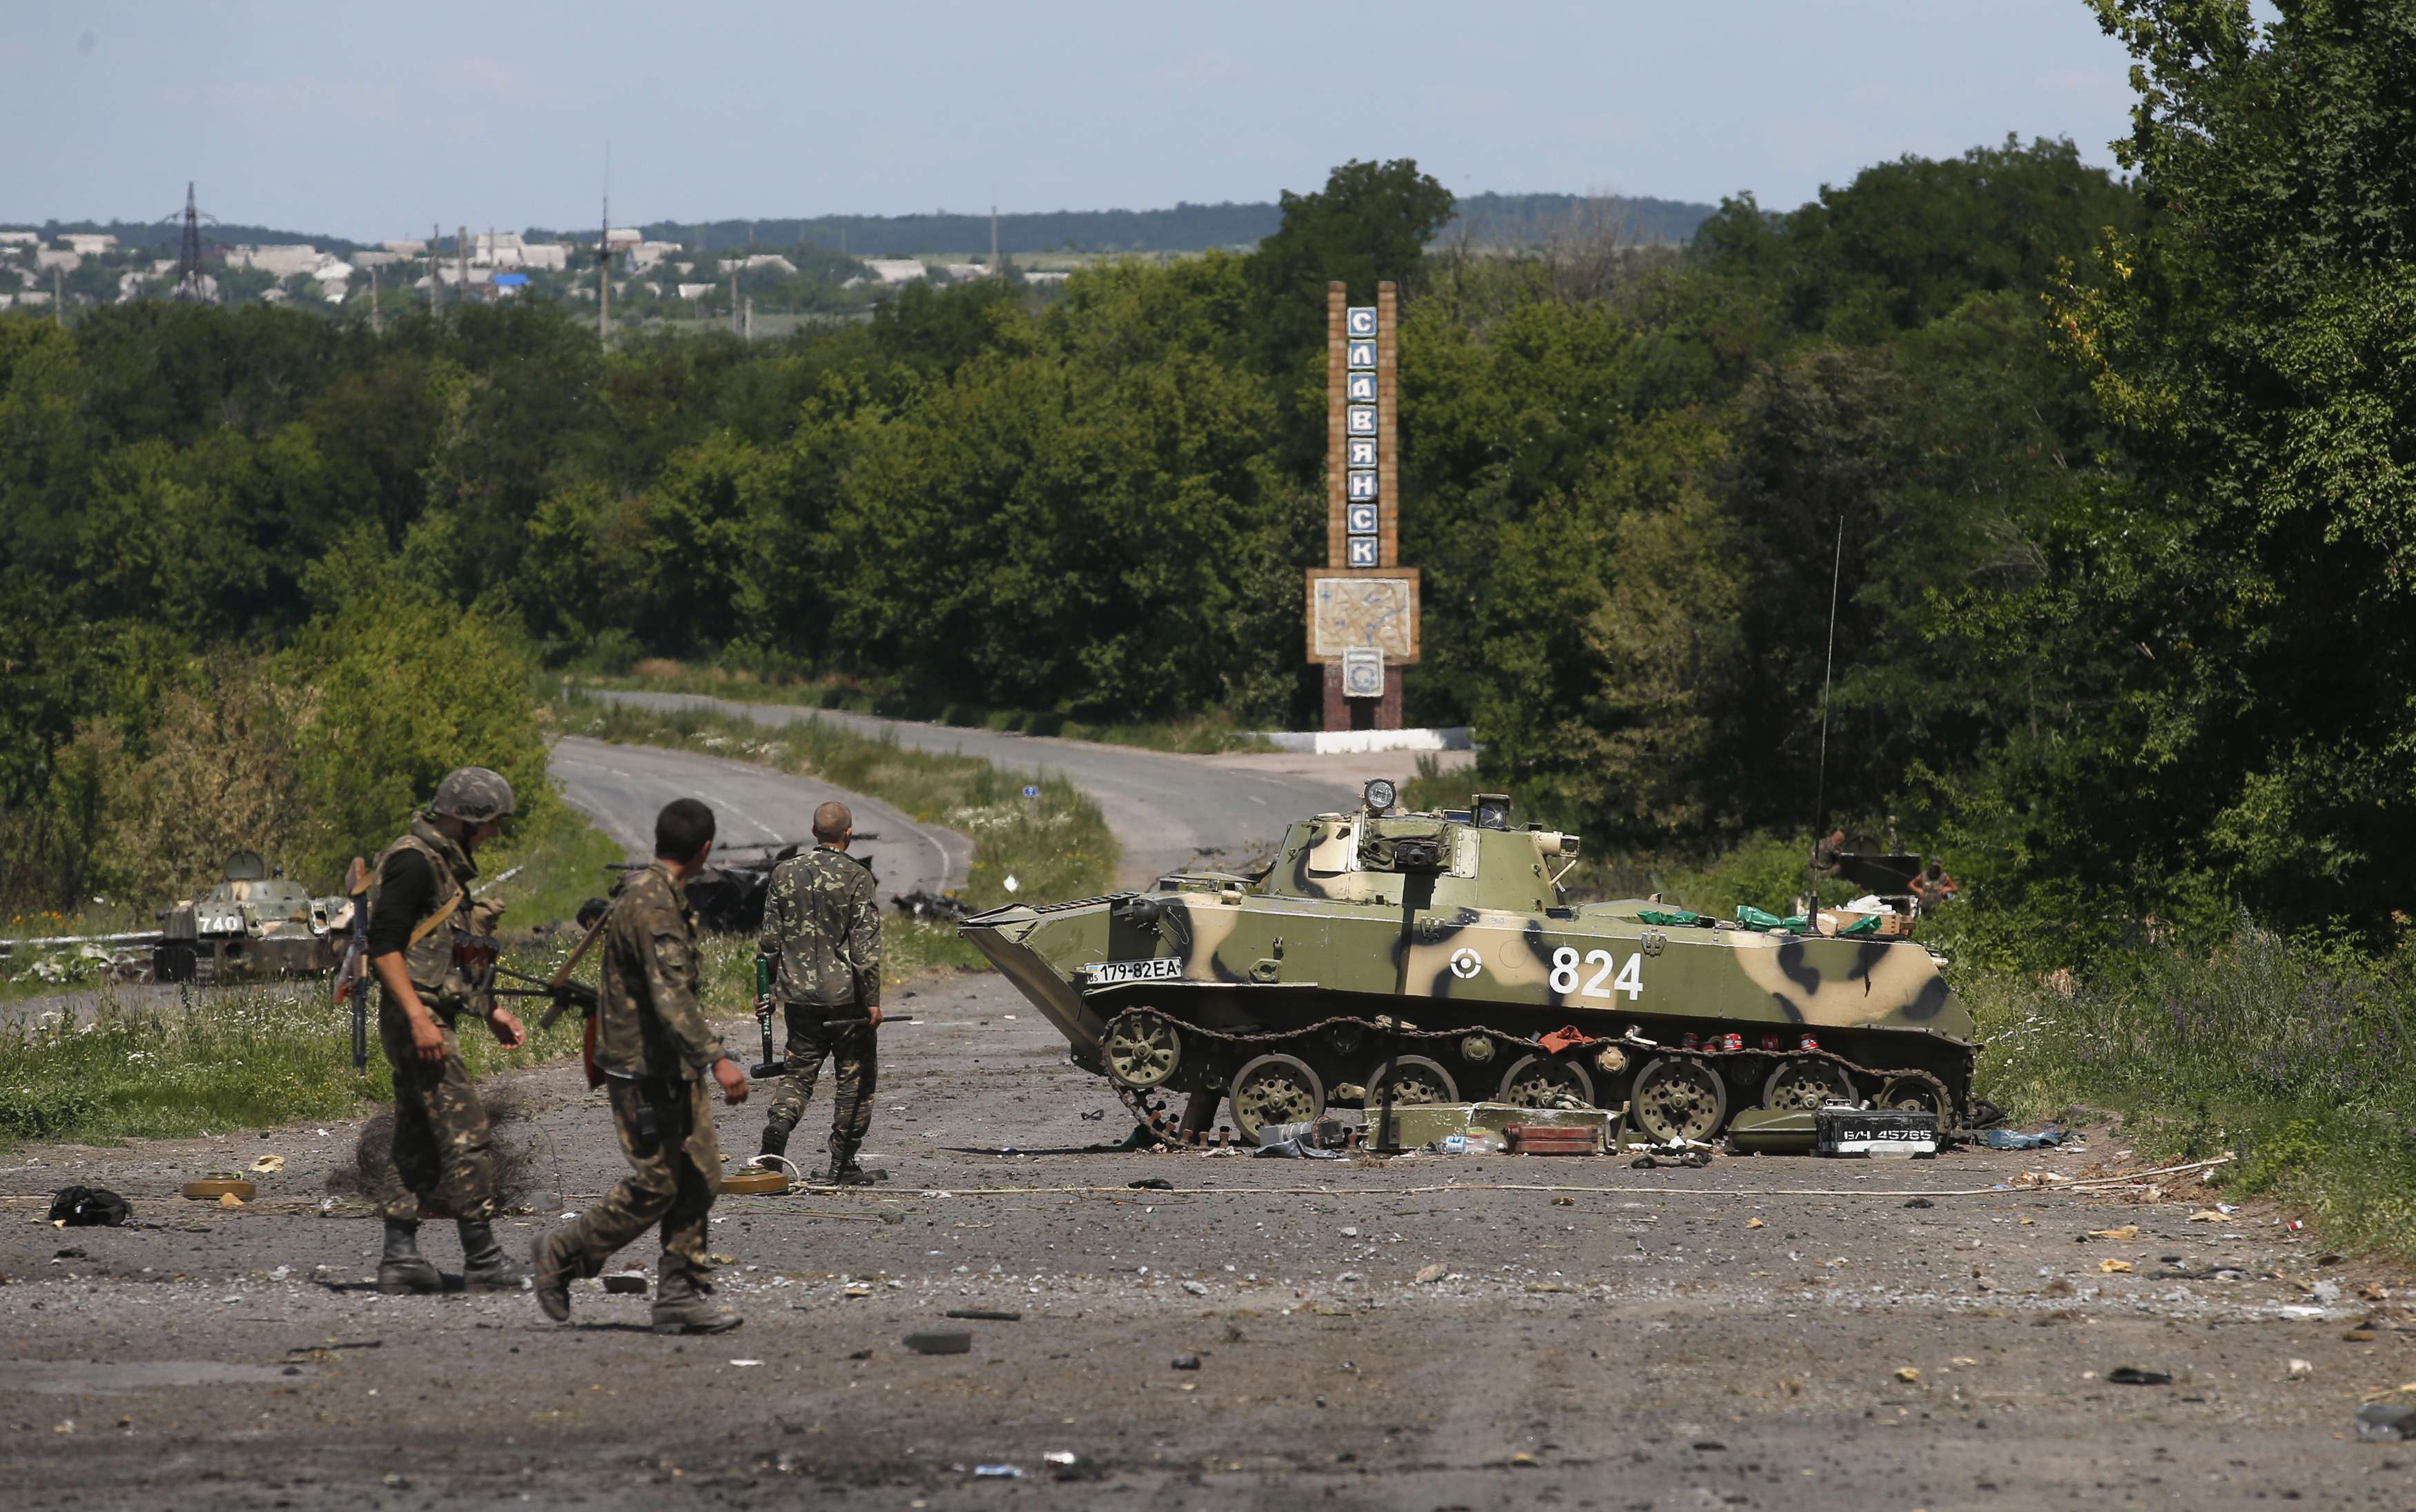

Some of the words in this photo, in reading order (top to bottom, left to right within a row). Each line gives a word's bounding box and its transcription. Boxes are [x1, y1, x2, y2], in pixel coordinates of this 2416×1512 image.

[1350, 311, 1373, 564] СЛАВЯНСК
[198, 916, 238, 932] 740
[1549, 946, 1644, 1001] 824
[1877, 1130, 1931, 1140] 45765
